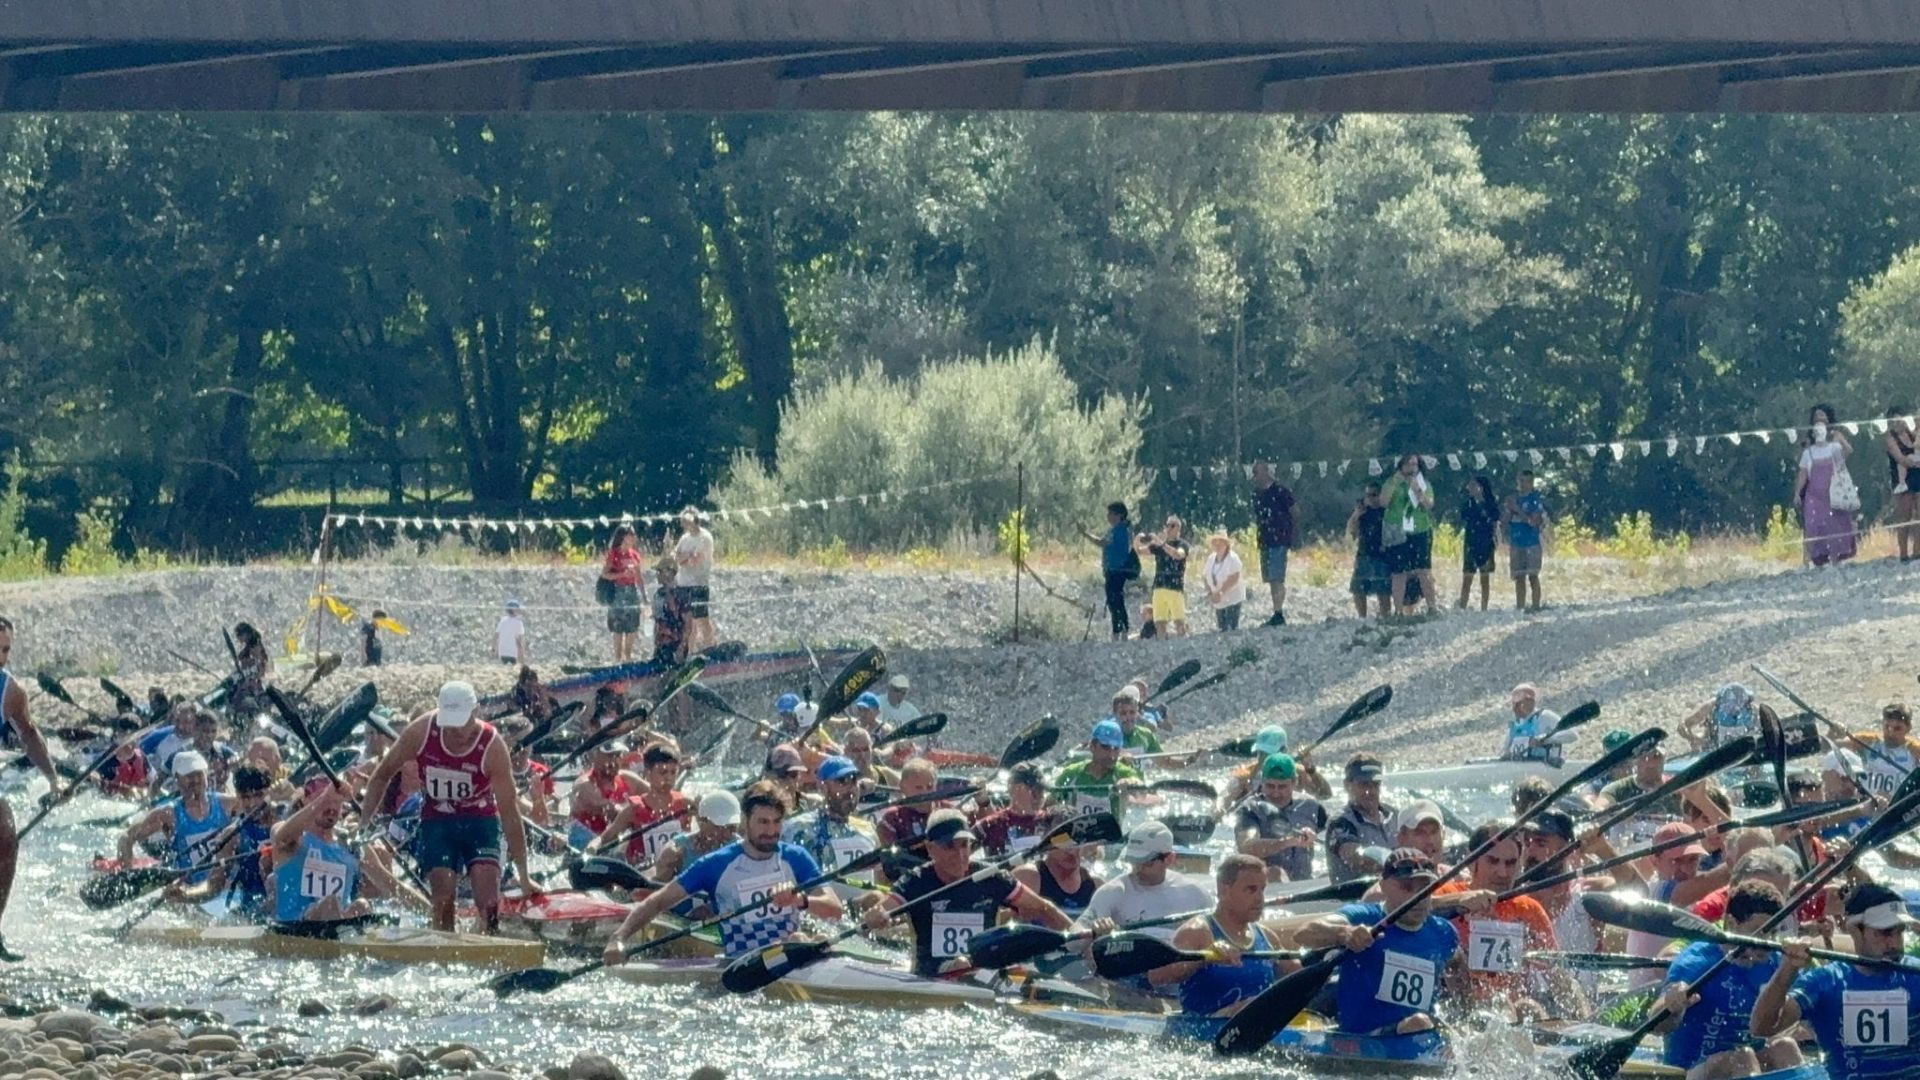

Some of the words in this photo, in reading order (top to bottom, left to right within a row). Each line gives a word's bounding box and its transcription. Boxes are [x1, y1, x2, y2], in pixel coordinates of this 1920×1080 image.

[429, 778, 471, 799] 118
[1868, 772, 1894, 793] 106
[305, 871, 343, 897] 112
[943, 927, 973, 955] 83
[1480, 937, 1513, 969] 74
[1391, 970, 1424, 1006] 68
[1856, 1008, 1890, 1044] 61
